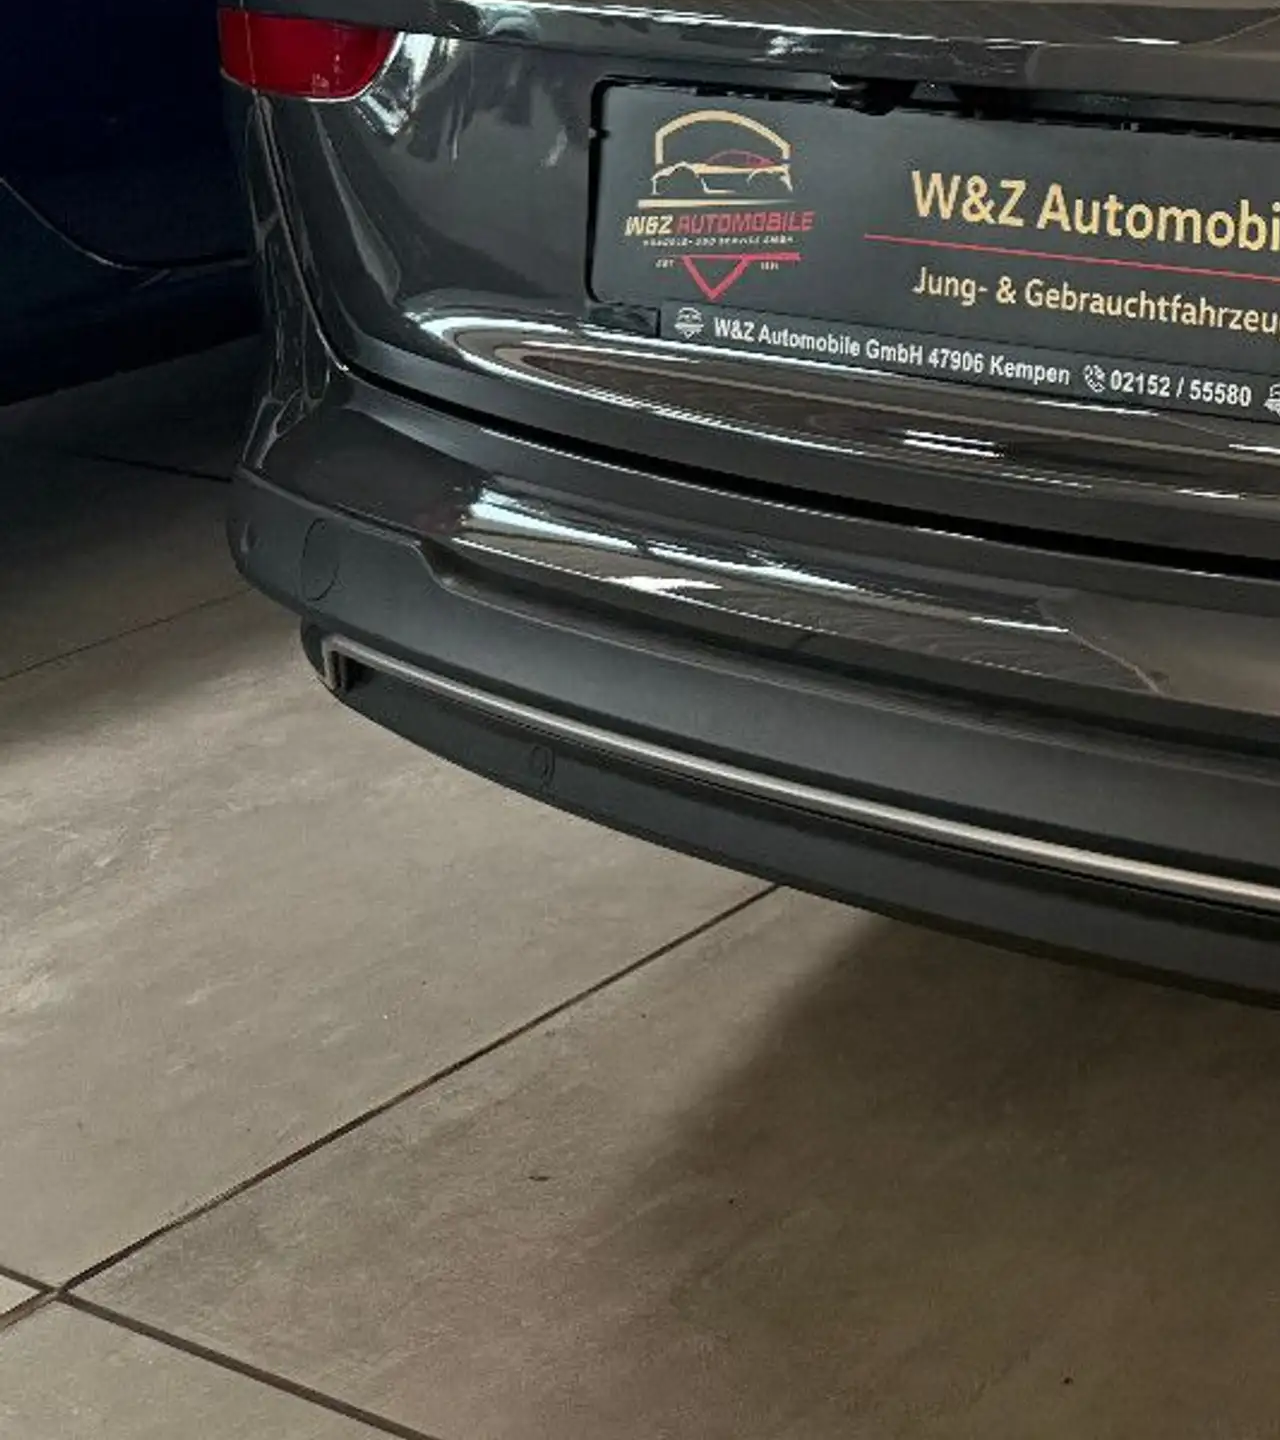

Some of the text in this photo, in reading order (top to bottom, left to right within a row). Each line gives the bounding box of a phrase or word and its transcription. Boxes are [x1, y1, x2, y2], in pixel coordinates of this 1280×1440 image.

[911, 169, 1027, 227] W&Z
[624, 211, 815, 237] W&Z AUTOMOBILE
[912, 266, 988, 306] Jung-
[996, 276, 1017, 304] &
[713, 316, 1253, 407] W&Z Automobile GmbH 47906 Kempen 02152 / 55580
